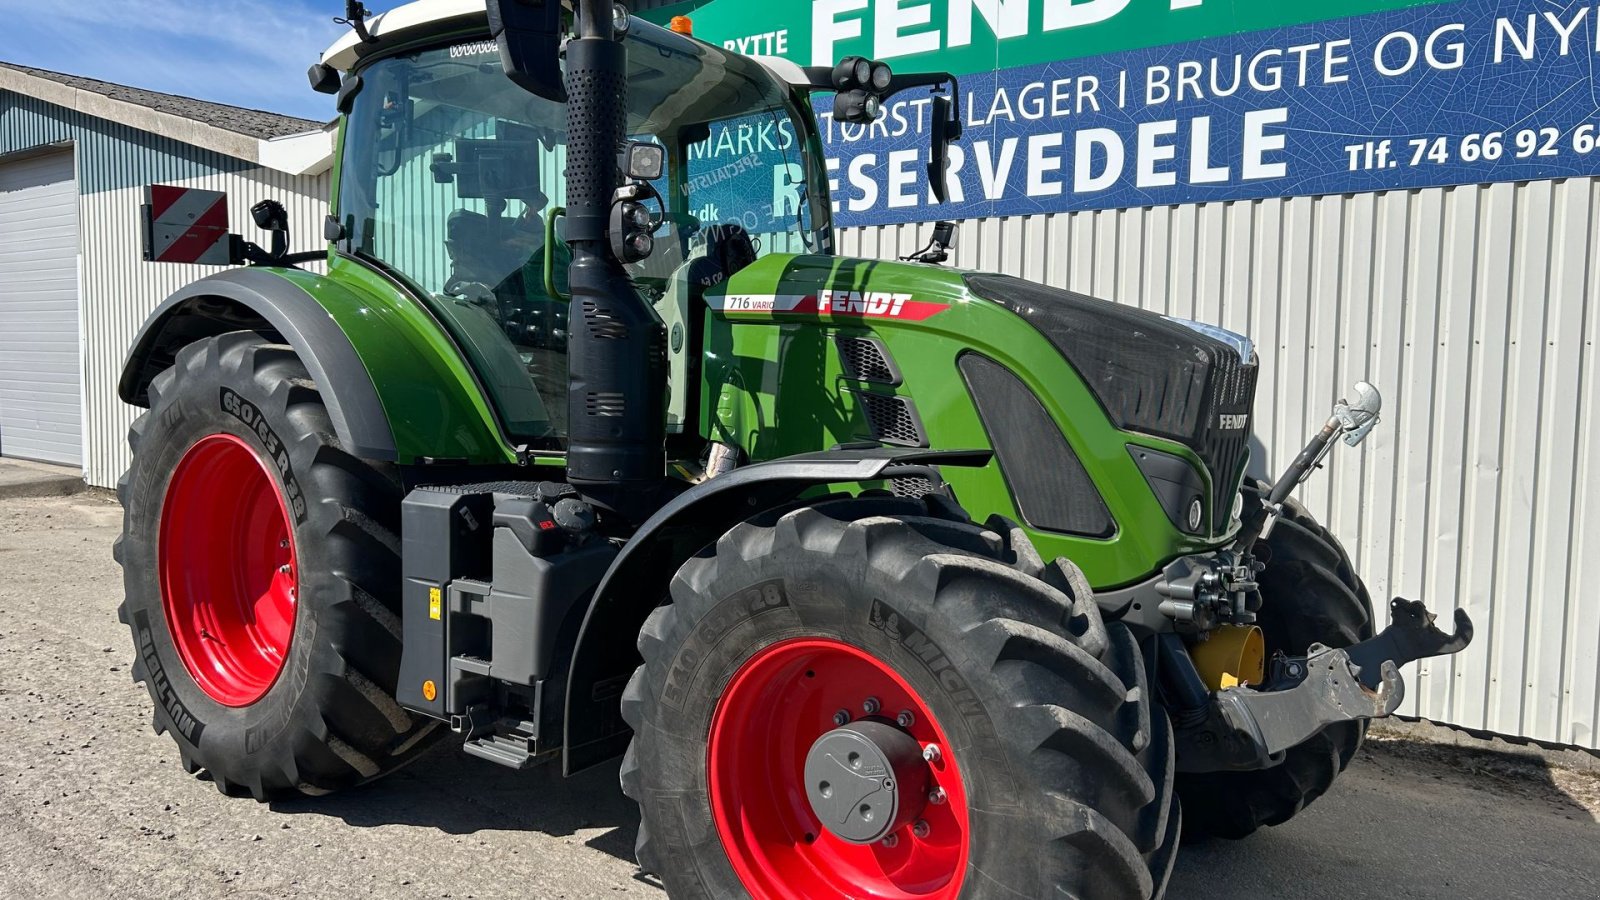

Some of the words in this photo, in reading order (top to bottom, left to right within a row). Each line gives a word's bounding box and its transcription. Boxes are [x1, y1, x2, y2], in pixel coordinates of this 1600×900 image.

[812, 0, 1204, 68] FEN
[815, 96, 952, 147] TØRST
[967, 75, 1101, 127] LAGER
[1118, 70, 1126, 109] I
[1145, 38, 1351, 106] BRUGTE
[1373, 23, 1465, 77] OG
[1493, 5, 1600, 64] NY
[1344, 138, 1397, 171] Tlf.
[1409, 137, 1449, 167] 74
[1460, 132, 1502, 162] 66
[1515, 127, 1559, 158] 92
[1572, 124, 1600, 155] 6
[730, 296, 751, 310] 716
[752, 300, 776, 310] VARIO
[816, 289, 914, 317] FENDT
[1219, 413, 1248, 430] FENDT
[223, 391, 278, 454] 650/65
[277, 449, 290, 476] R
[286, 480, 306, 519] 38
[140, 627, 196, 740] MULTIBIB
